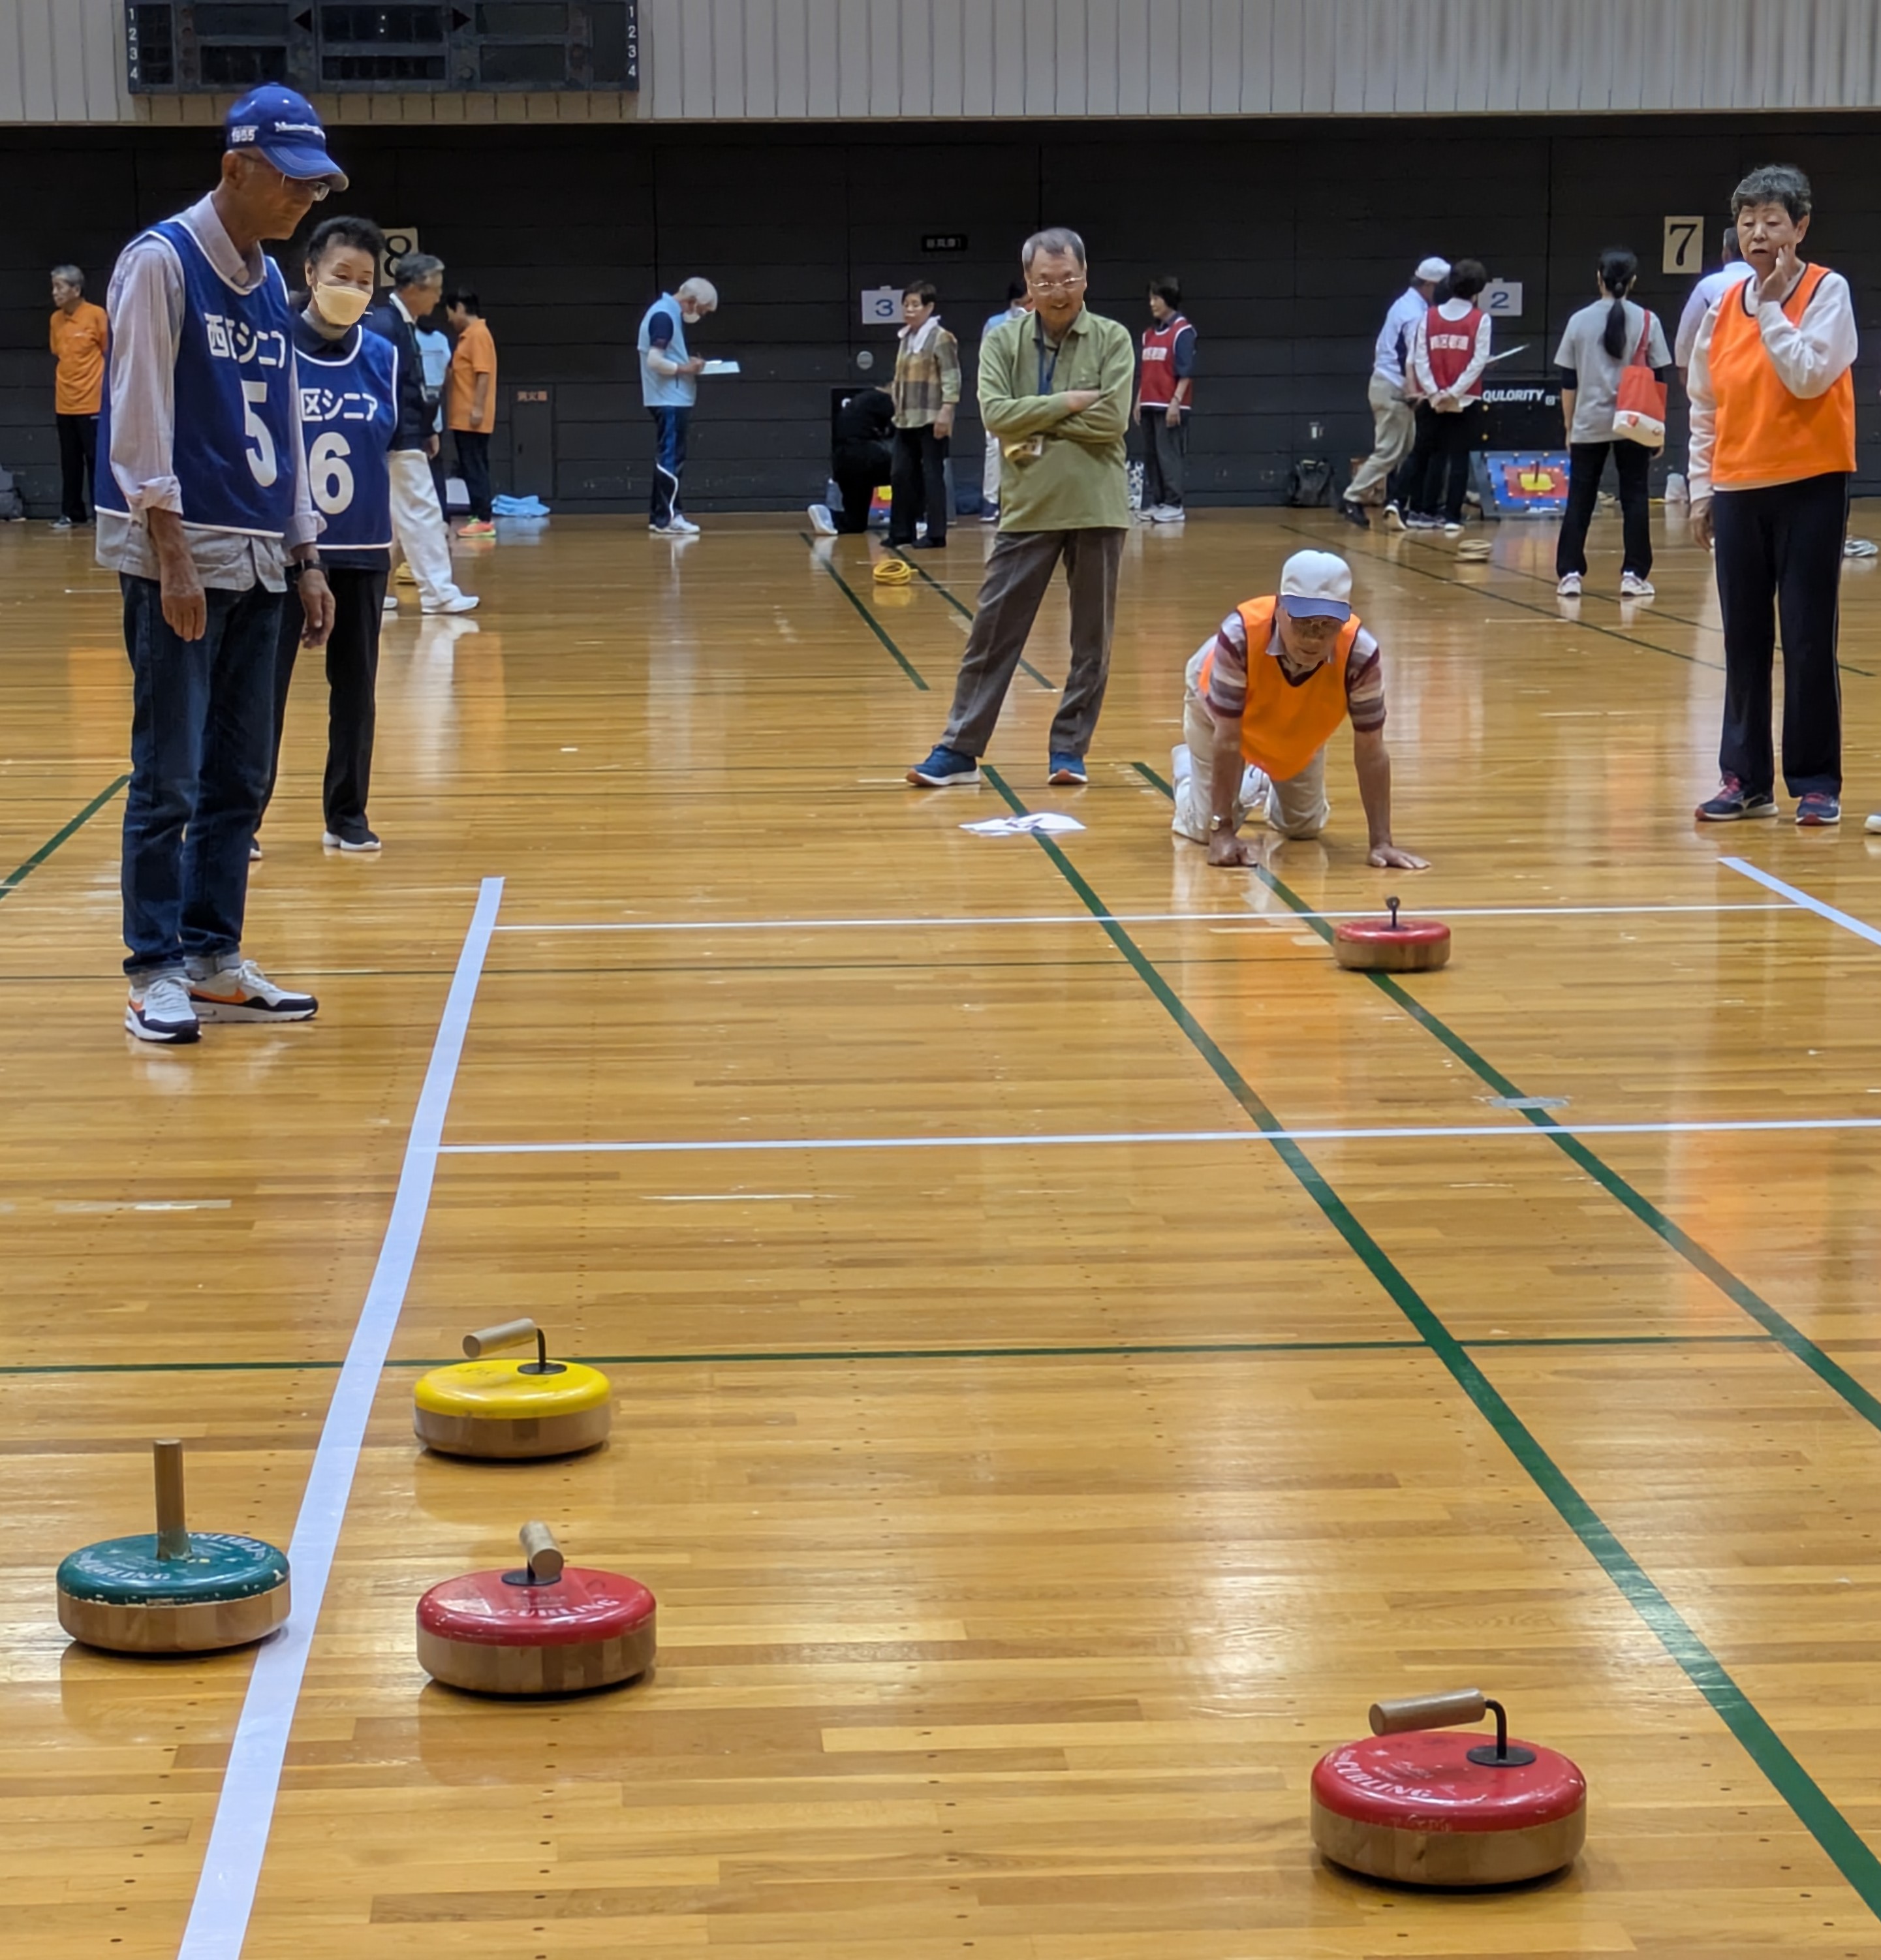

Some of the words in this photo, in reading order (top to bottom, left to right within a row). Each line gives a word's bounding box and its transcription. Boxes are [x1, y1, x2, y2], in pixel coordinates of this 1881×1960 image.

[129, 8, 134, 20] 1
[629, 6, 634, 18] 1
[129, 27, 138, 40] 2
[628, 25, 636, 38] 2
[129, 47, 138, 60] 3
[628, 45, 636, 57] 3
[130, 67, 138, 79] 4
[628, 65, 636, 76] 4
[1670, 224, 1698, 266] 7
[875, 299, 894, 317] 3
[1491, 292, 1510, 309] 2
[300, 388, 379, 422] 区シニア
[241, 379, 278, 488] 5
[309, 431, 354, 515] 6
[189, 1533, 266, 1552] CURLIN
[1334, 1762, 1433, 1797] CURLING
